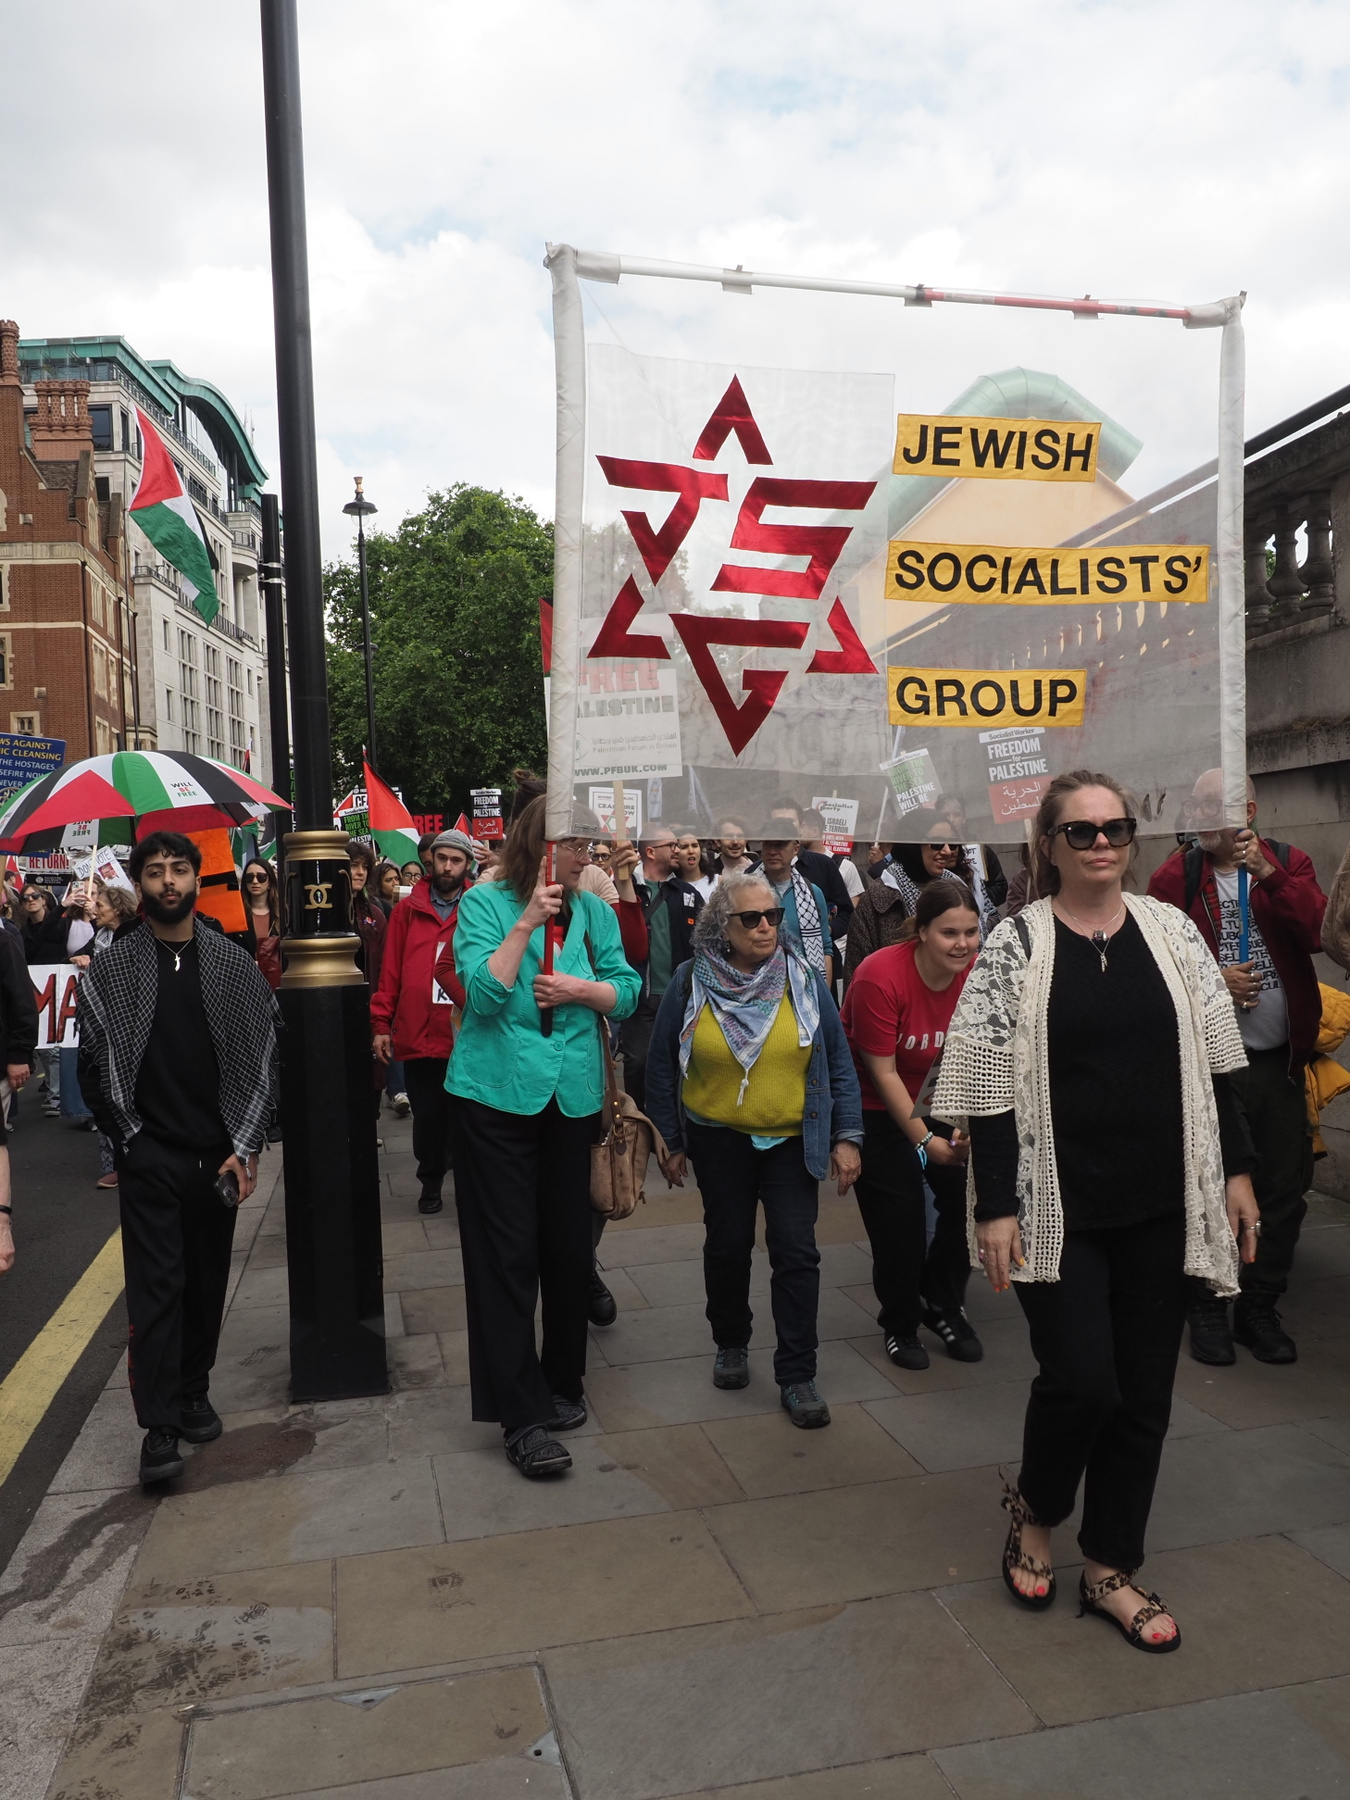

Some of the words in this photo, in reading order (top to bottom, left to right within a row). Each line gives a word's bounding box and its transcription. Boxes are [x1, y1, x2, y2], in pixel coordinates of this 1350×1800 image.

[902, 424, 1093, 472] JEWISH
[895, 550, 1202, 595] SOCIALISTS'
[896, 676, 1078, 717] GROUP
[12, 740, 52, 750] AGAINST
[987, 737, 1041, 759] FREEDOM
[12, 749, 61, 761] CLEANSING
[988, 759, 1048, 781] PALESTINE
[474, 796, 499, 805] FREEDOM
[896, 781, 935, 802] PALESTINE
[899, 797, 918, 811] WILL
[918, 793, 930, 803] BE
[473, 807, 500, 817] PALESTINE
[29, 854, 69, 869] RETURN!
